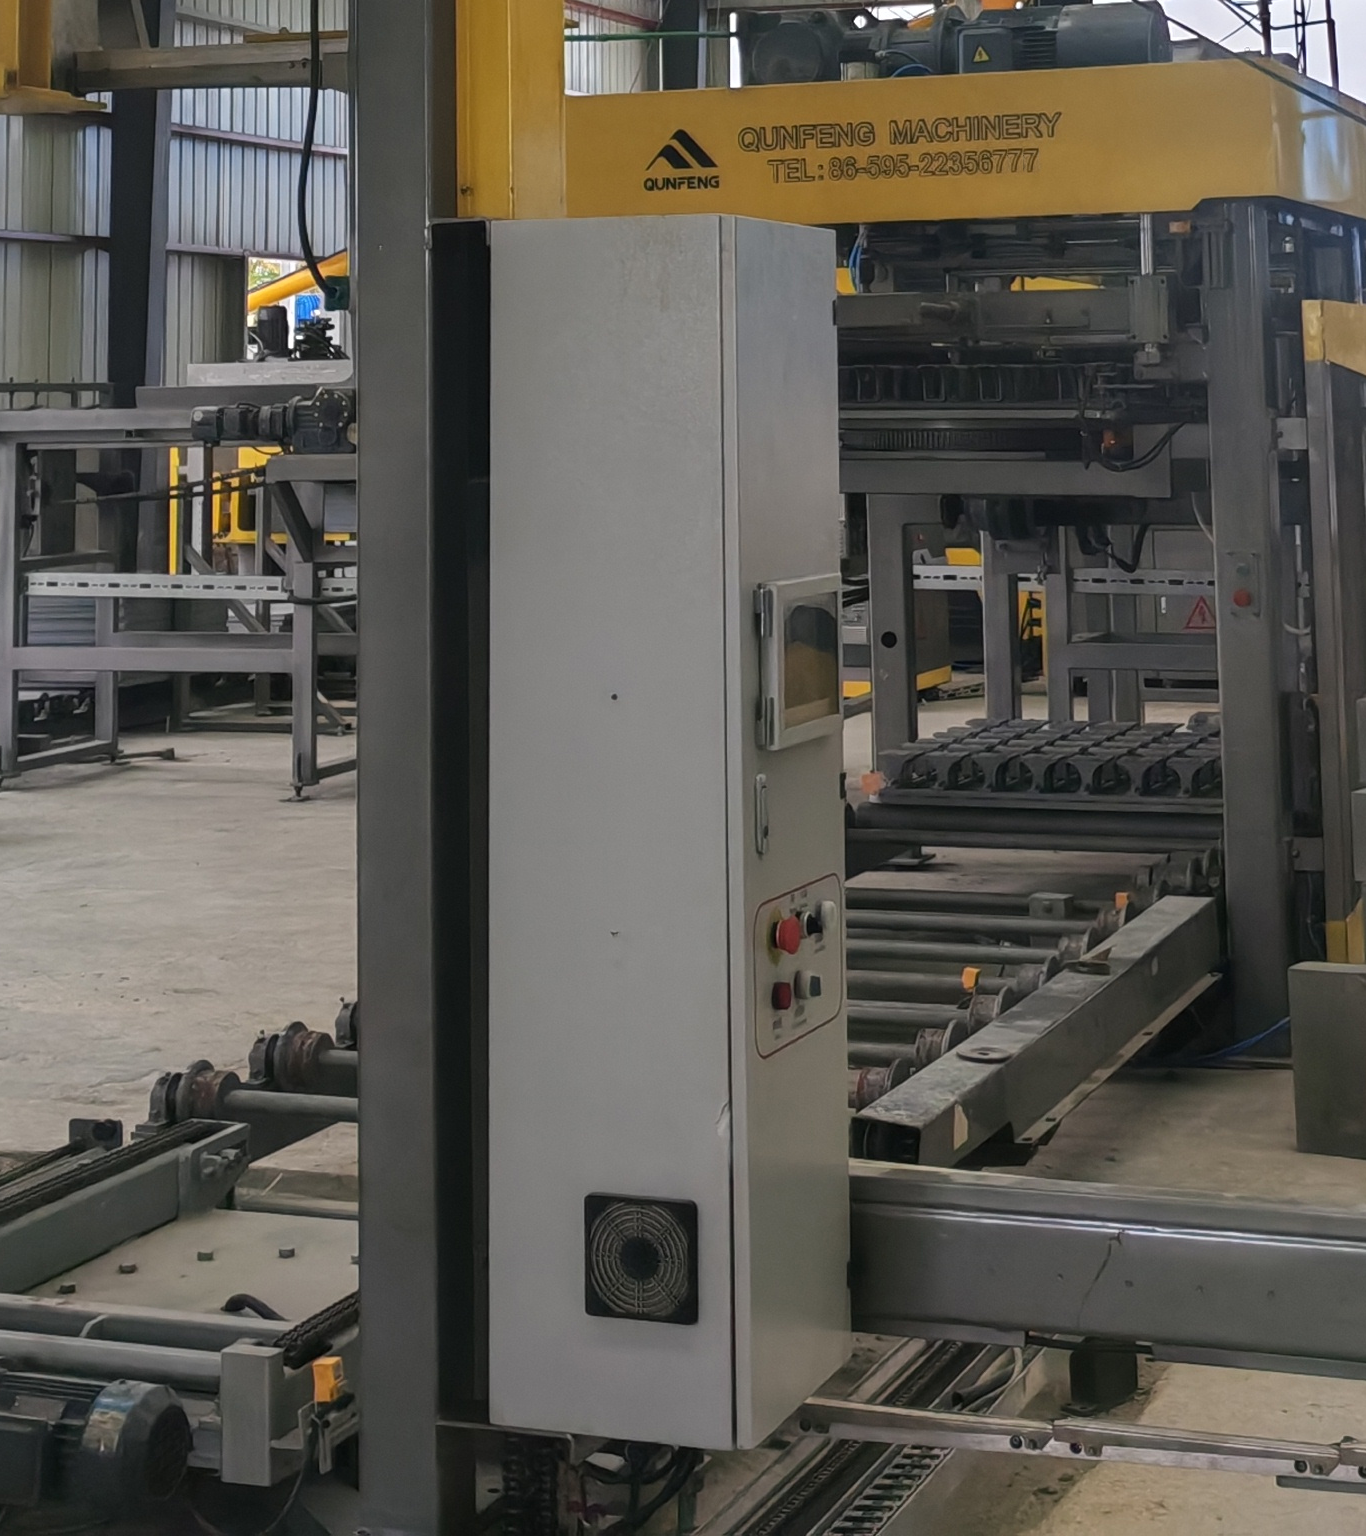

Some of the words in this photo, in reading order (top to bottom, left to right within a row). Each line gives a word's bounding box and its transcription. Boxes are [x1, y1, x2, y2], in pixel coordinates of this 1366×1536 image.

[738, 121, 876, 153] QUNFENG
[889, 112, 1062, 145] MACHINERY
[643, 175, 720, 192] QUNFENG
